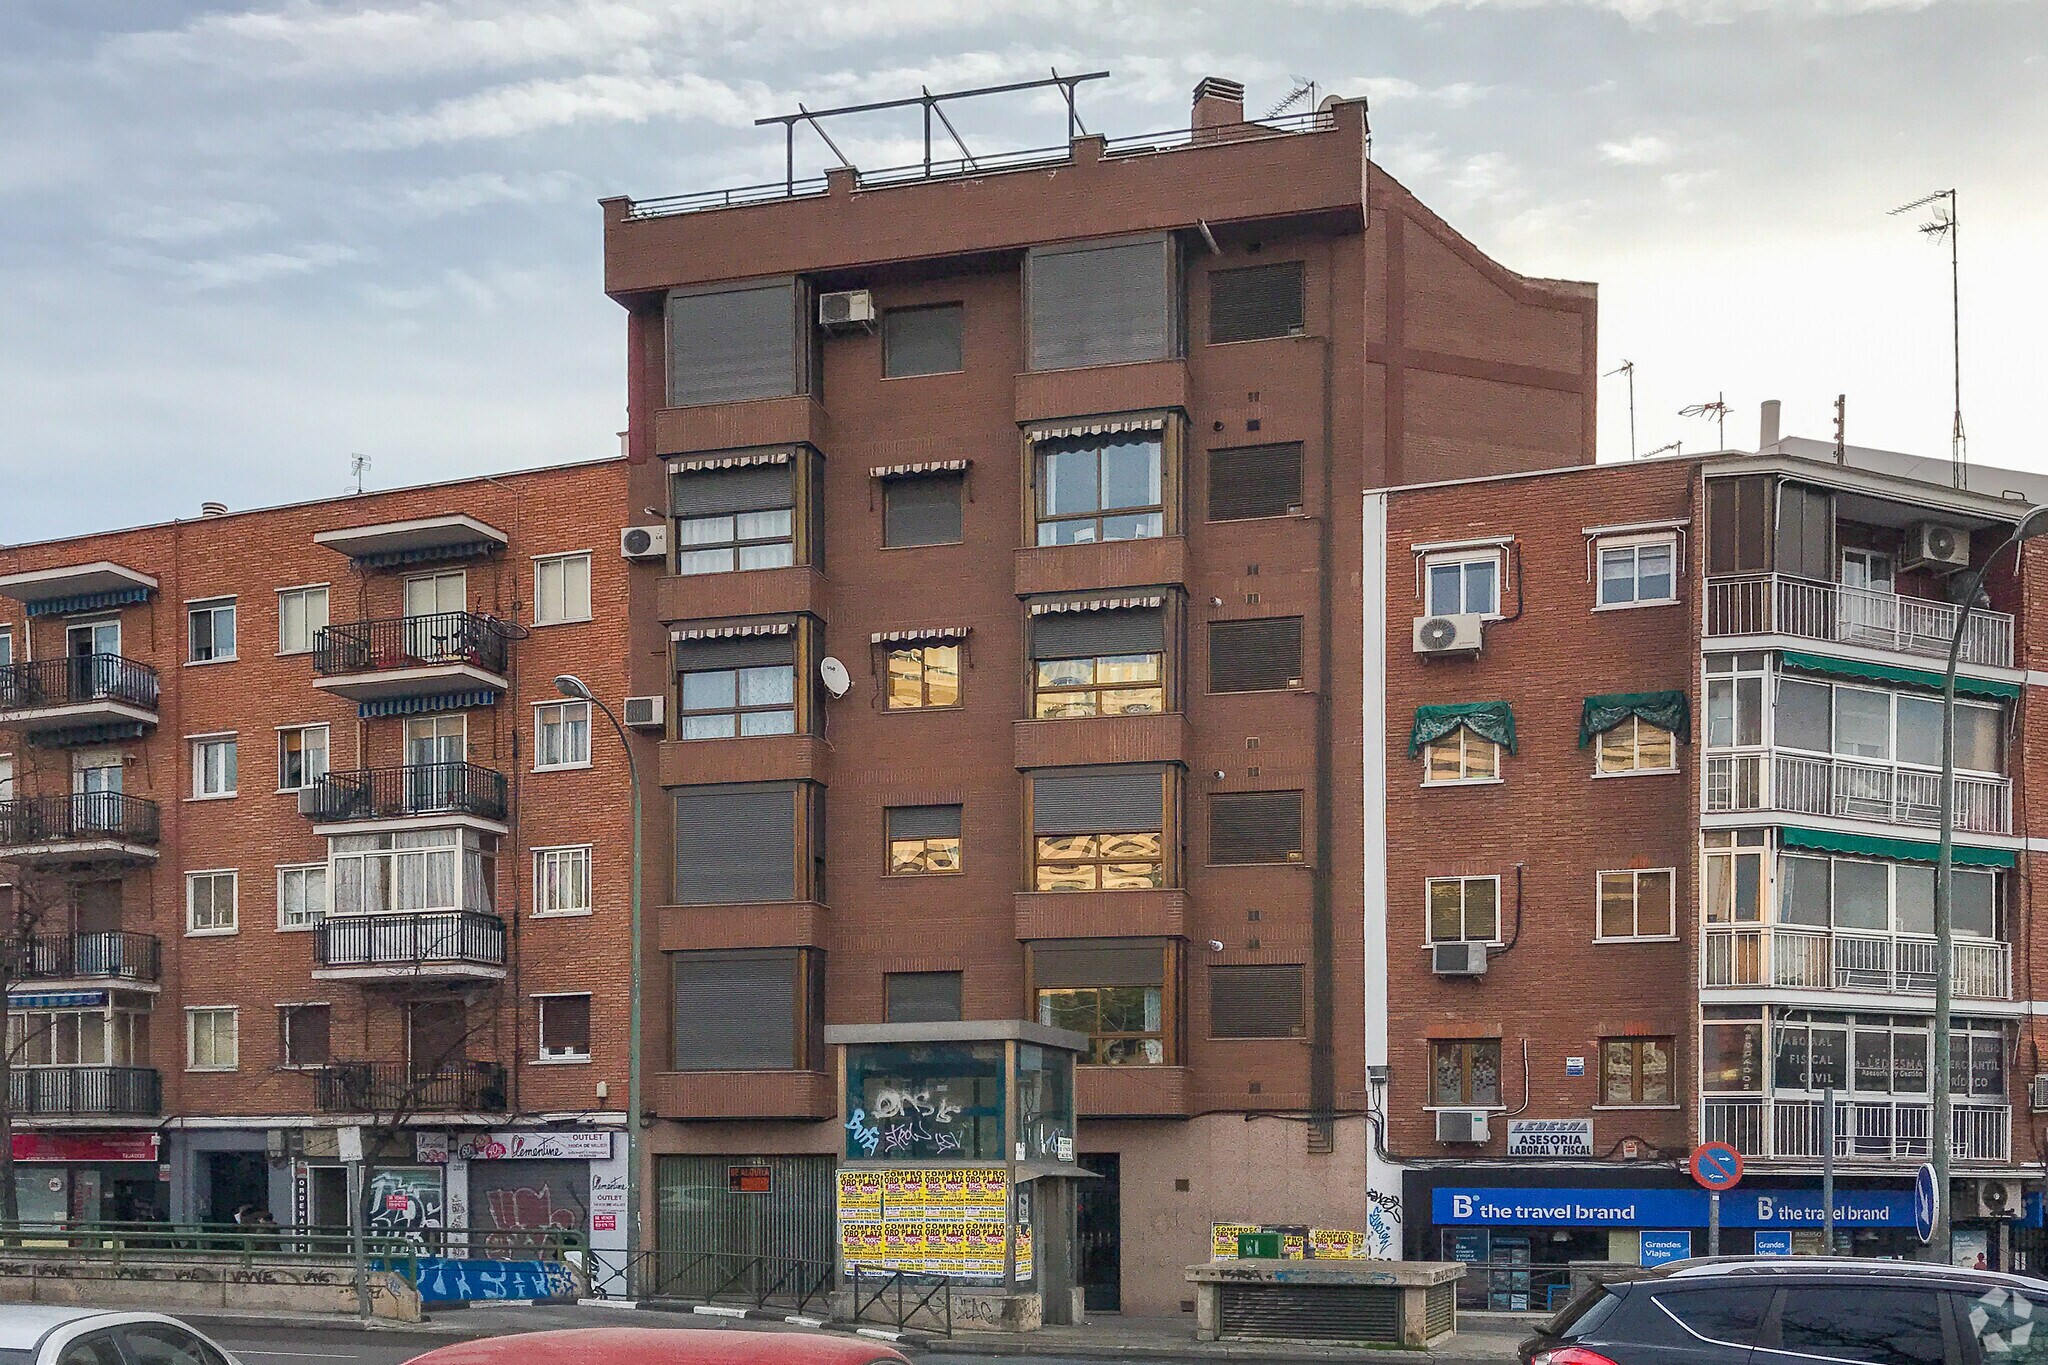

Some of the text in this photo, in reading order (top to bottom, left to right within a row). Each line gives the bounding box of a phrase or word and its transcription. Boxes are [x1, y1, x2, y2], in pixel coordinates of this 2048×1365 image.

[1789, 1054, 1834, 1065] FISCAL
[1950, 1060, 2001, 1071] ERCANTIL
[1519, 1135, 1582, 1145] ASESORIA
[1510, 1145, 1591, 1155] LABORAL Y FISCAL
[1479, 1204, 1512, 1219] the
[1515, 1204, 1571, 1219] travel
[1575, 1204, 1635, 1220] brand
[1779, 1205, 1802, 1221] the
[1805, 1205, 1845, 1220] trael
[1848, 1205, 1889, 1221] brand
[1645, 1249, 1671, 1258] Viajes
